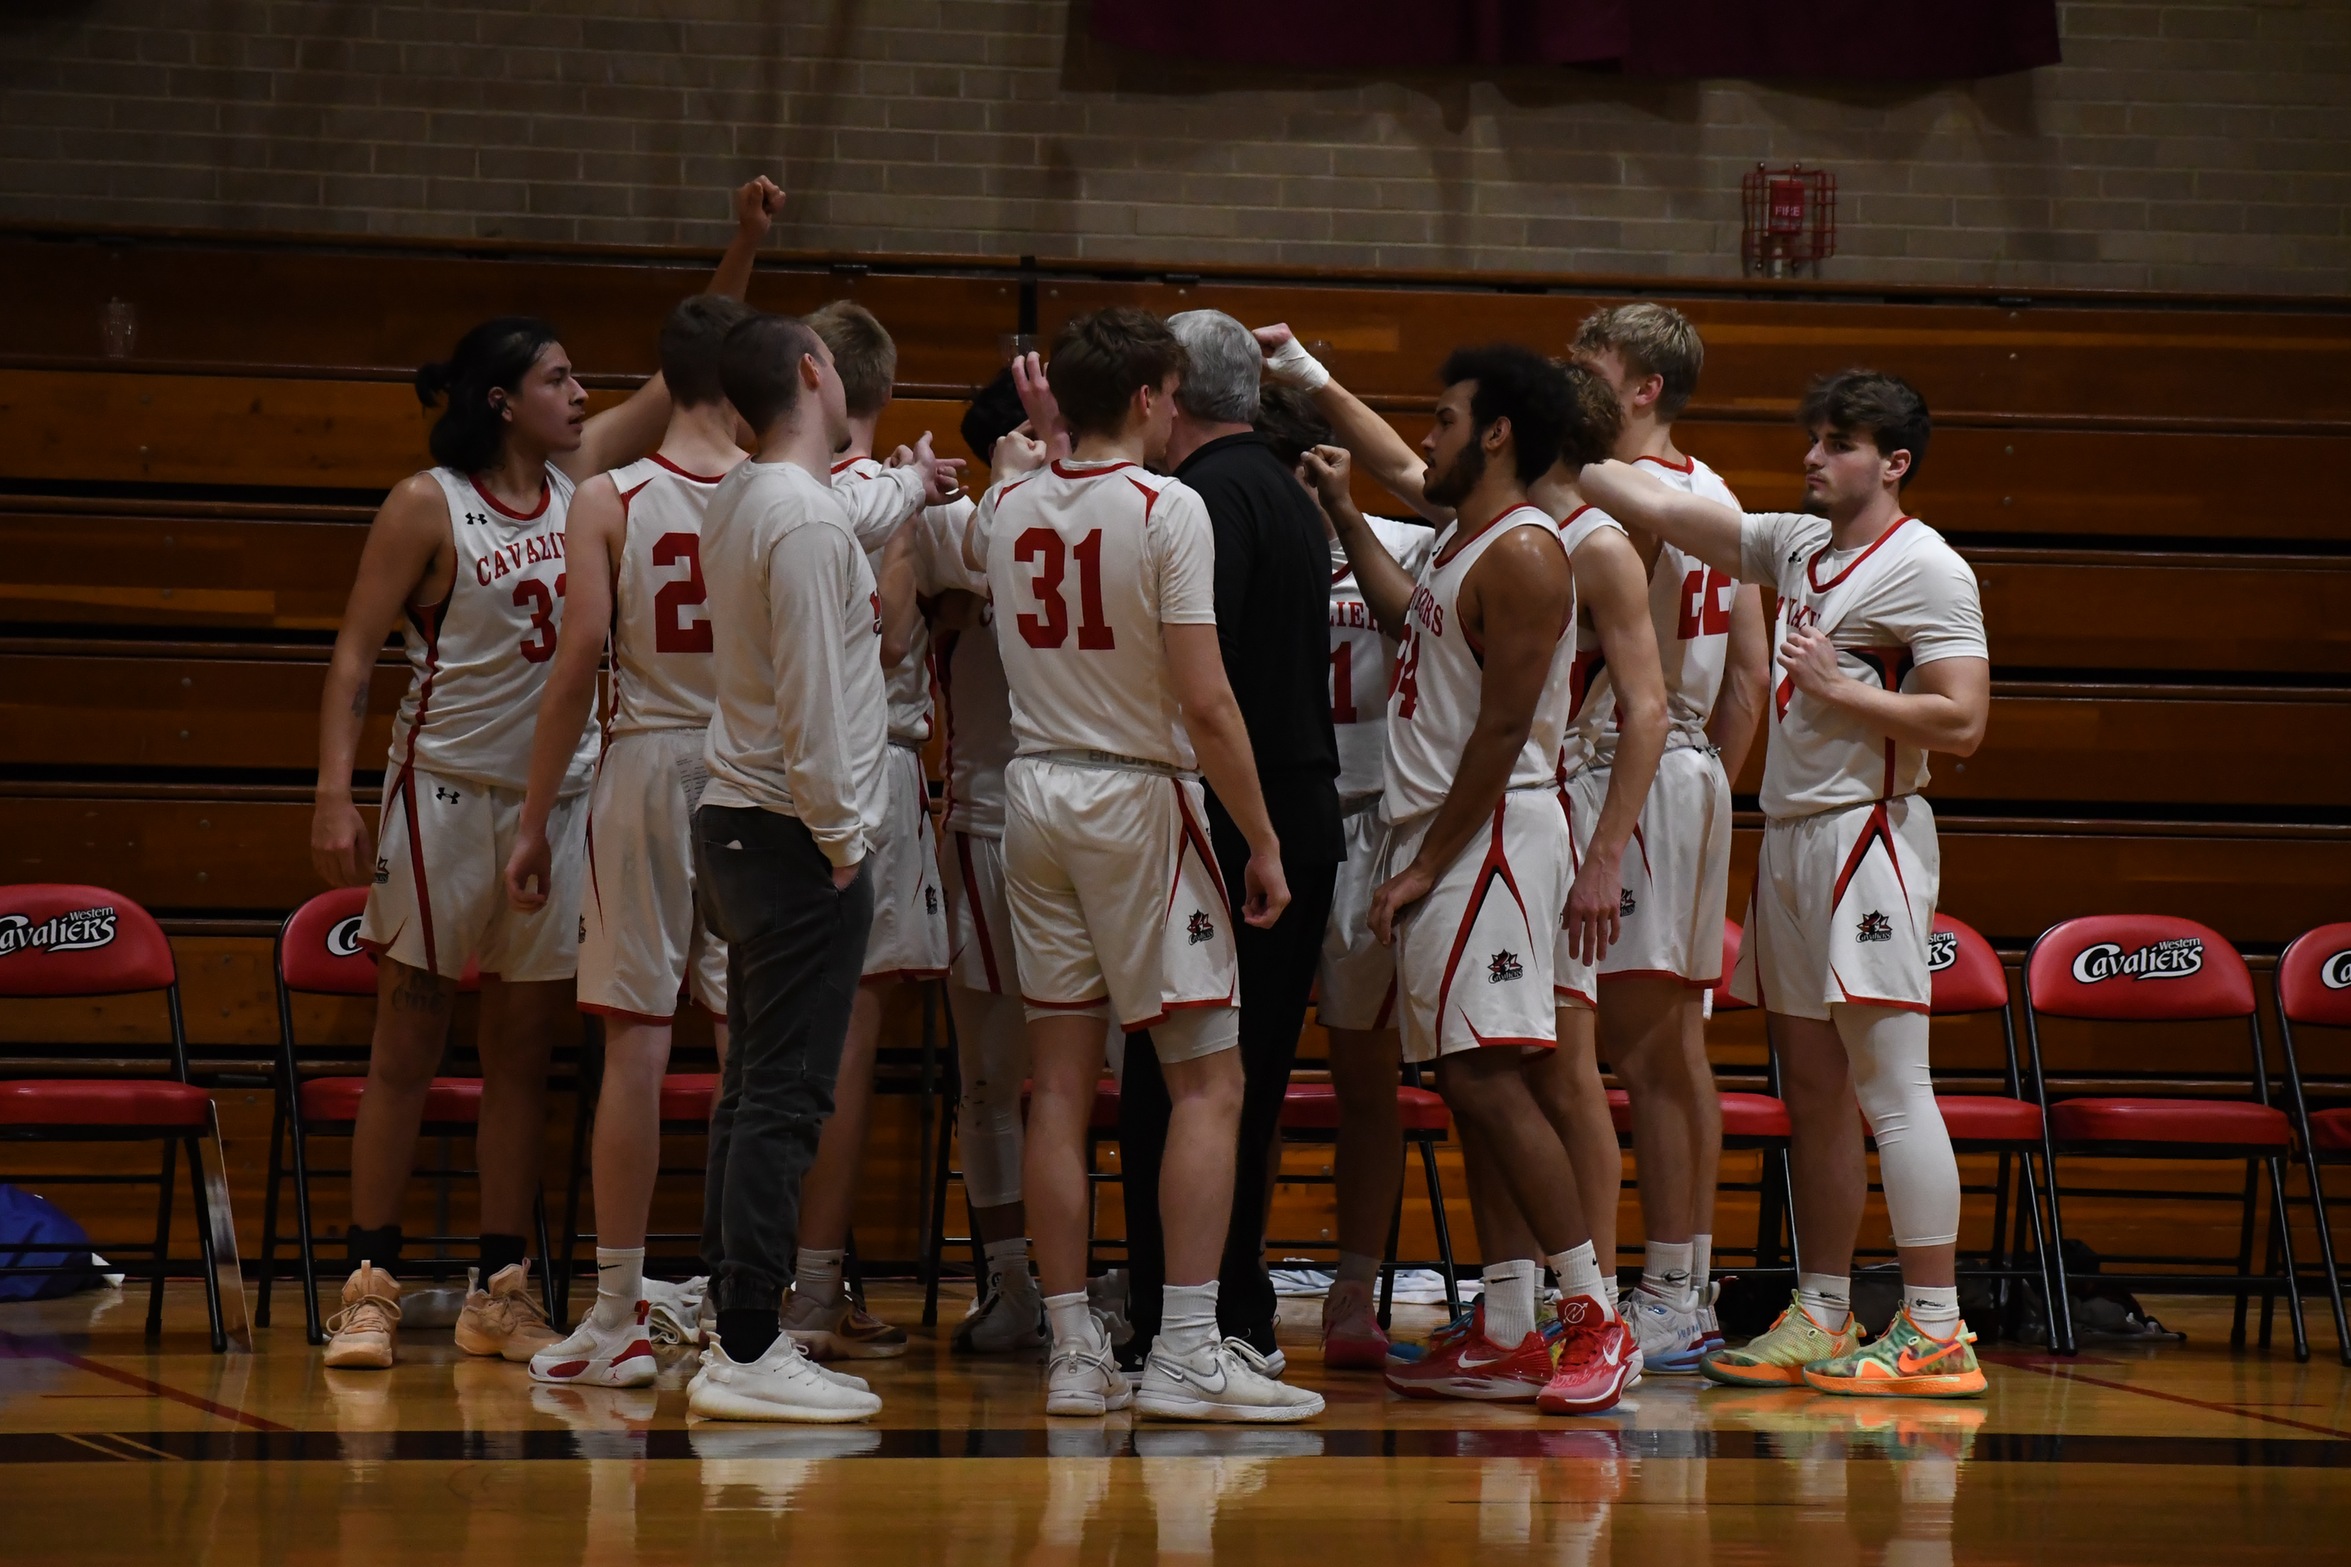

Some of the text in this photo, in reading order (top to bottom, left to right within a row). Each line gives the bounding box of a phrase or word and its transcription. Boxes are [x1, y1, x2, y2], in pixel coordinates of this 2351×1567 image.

[1774, 205, 1801, 217] FIRE
[1014, 527, 1115, 650] 31
[69, 906, 114, 921] Western
[2159, 937, 2200, 951] Western
